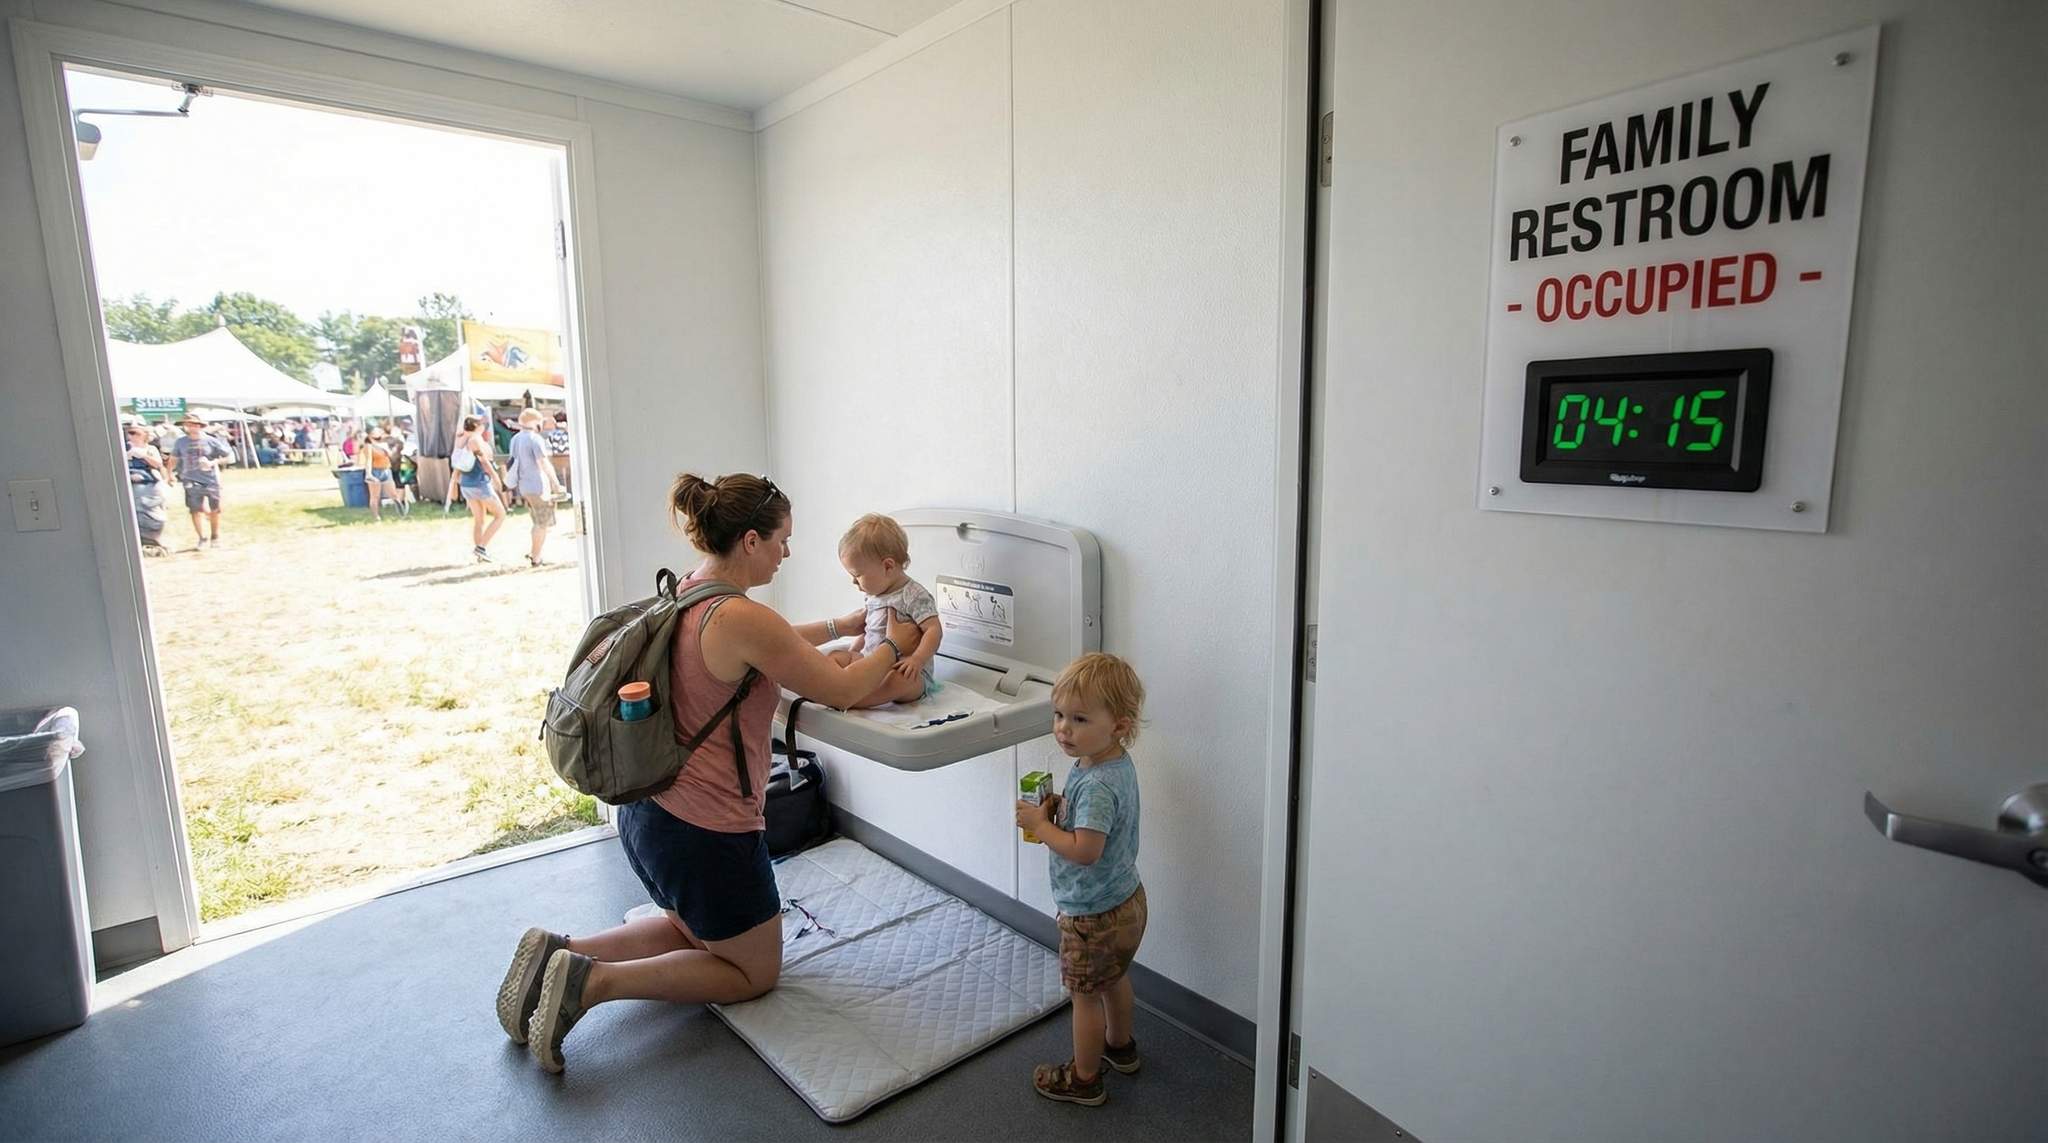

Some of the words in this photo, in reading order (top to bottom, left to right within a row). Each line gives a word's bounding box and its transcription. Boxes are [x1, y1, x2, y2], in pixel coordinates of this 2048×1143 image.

[1560, 82, 1772, 185] FAMILY
[1510, 153, 1832, 262] RESTROOM
[1536, 252, 1777, 322] OCCUPIED
[1553, 389, 1726, 452] 04:15
